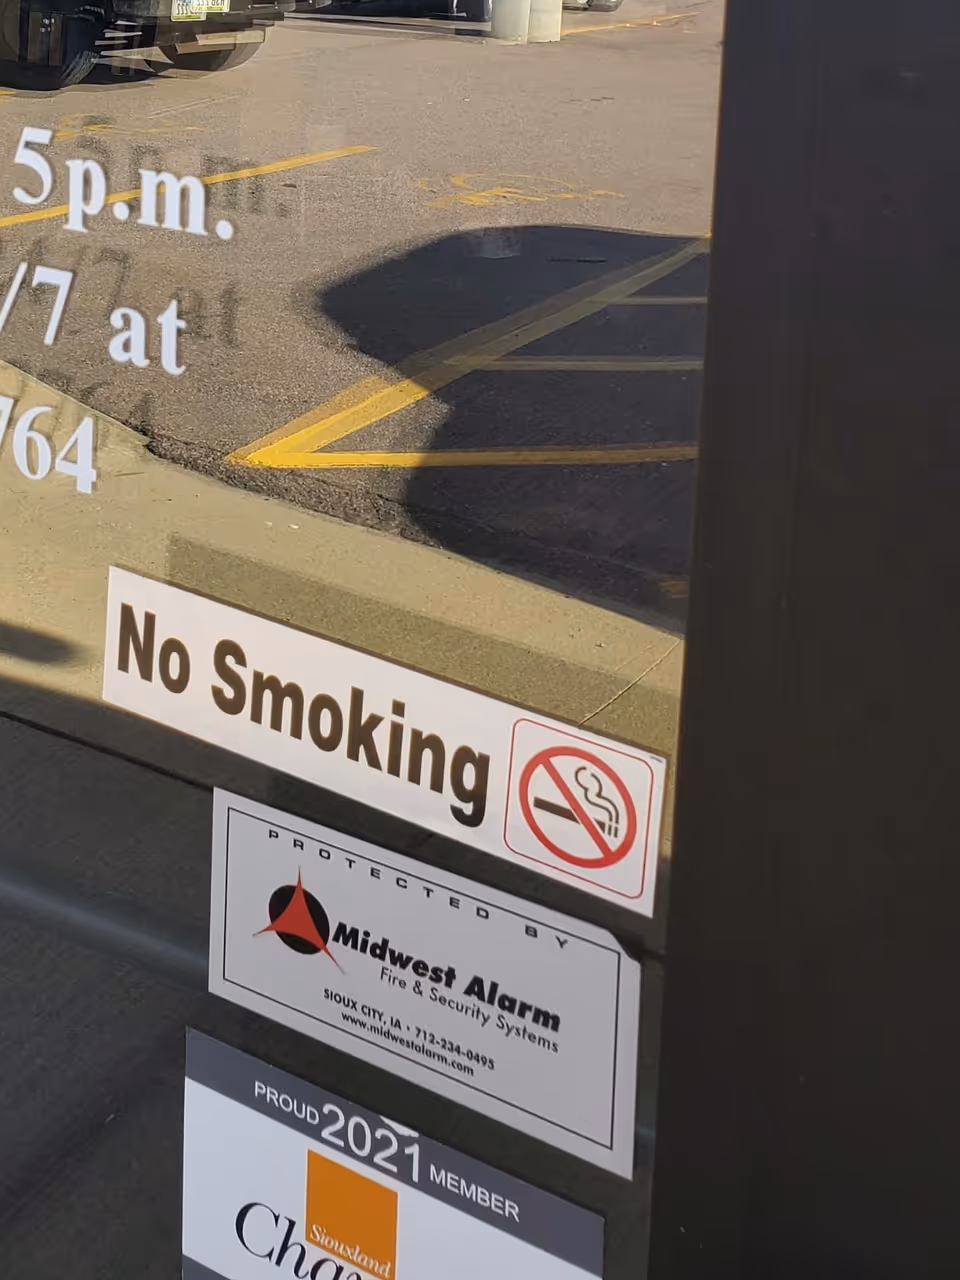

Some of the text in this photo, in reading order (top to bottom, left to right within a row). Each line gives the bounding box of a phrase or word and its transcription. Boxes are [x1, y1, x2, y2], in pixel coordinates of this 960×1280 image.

[11, 126, 234, 241] 5p.m.
[109, 300, 187, 375] at
[116, 602, 491, 828] No Smoking
[268, 829, 568, 949] PROTECTED BY
[332, 922, 562, 1033] Midwest Alarm
[380, 966, 559, 1054] Fire & Security Systems
[323, 988, 496, 1071] SIOUX CITY, IA 712-234-0495
[341, 1011, 475, 1077] www.midwestalarm.com
[254, 1080, 520, 1223] PROUD 2021 MEMBER
[235, 1202, 362, 1280] Cha
[310, 1224, 392, 1278] Siouxland
